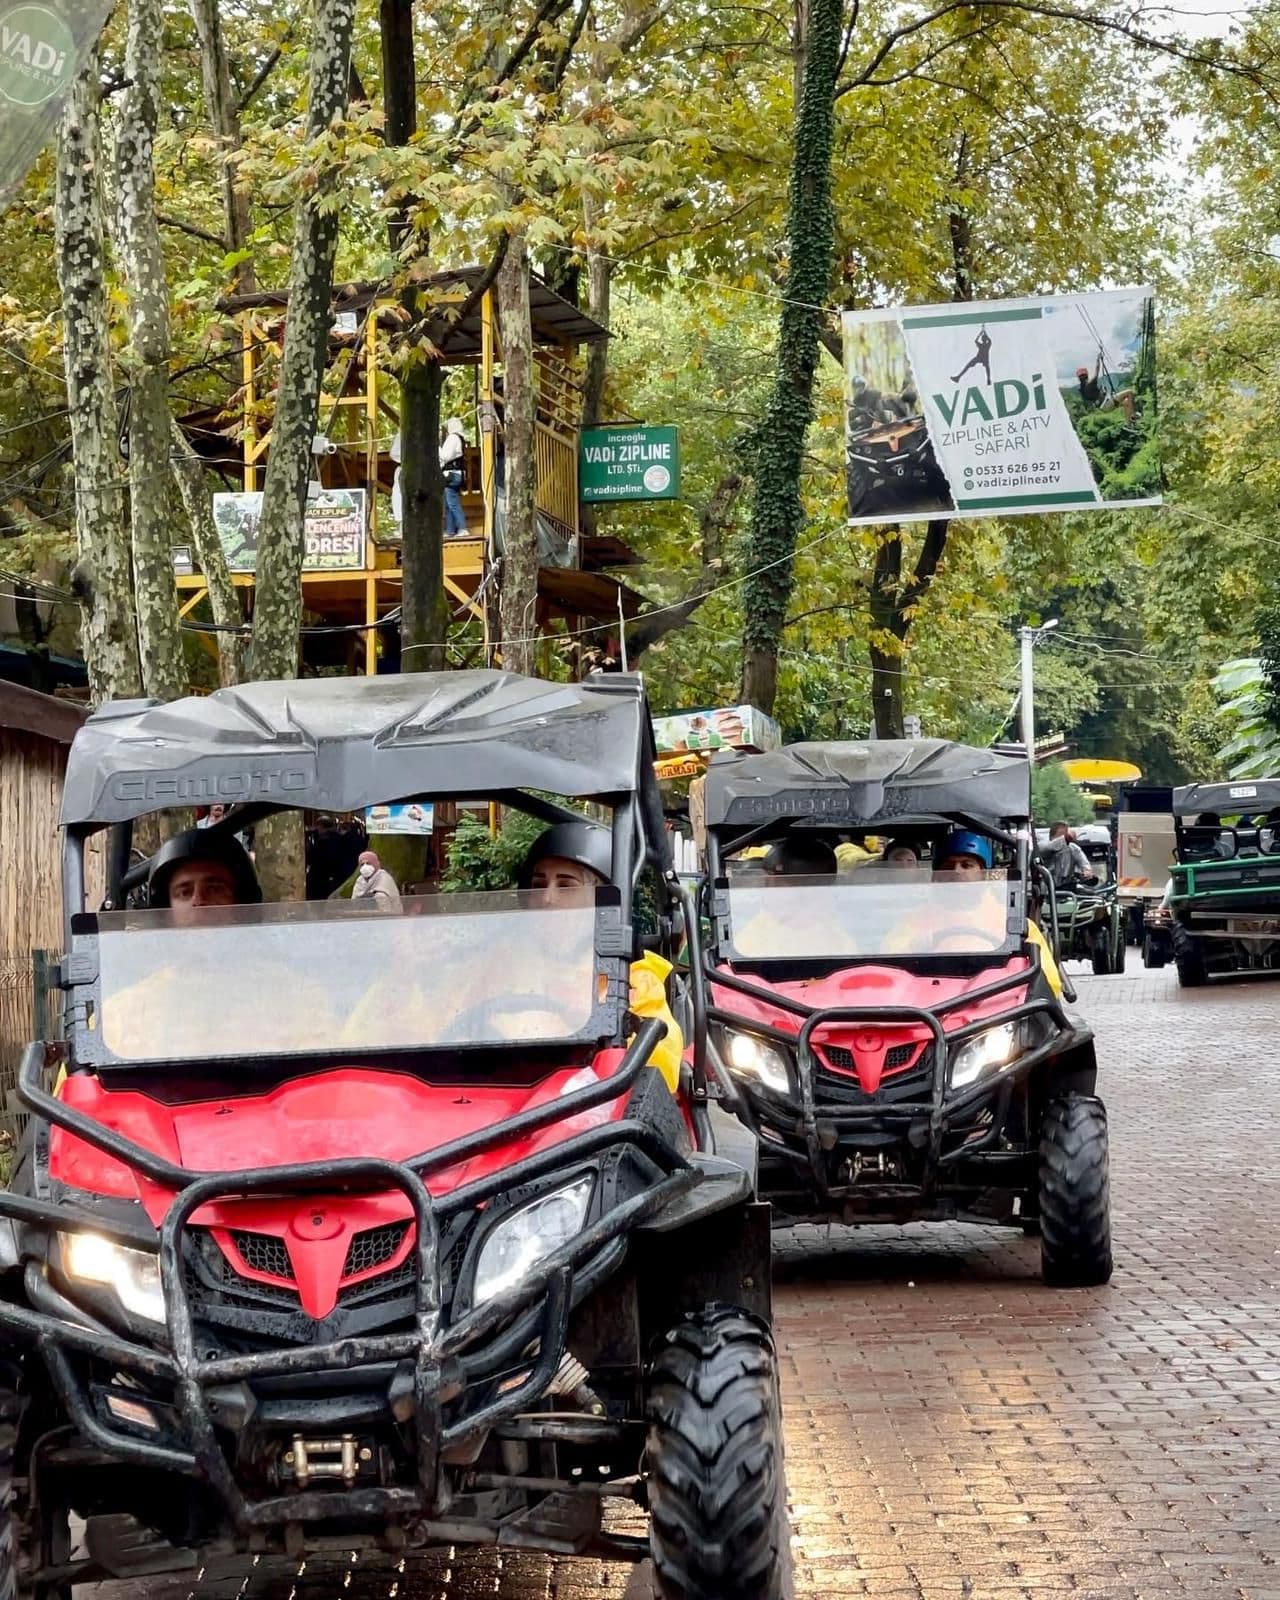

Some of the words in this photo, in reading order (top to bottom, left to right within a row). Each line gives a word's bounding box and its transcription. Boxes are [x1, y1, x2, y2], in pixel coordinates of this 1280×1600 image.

[942, 423, 1003, 447] ZIPLINE
[1007, 421, 1018, 434] &
[1021, 415, 1051, 432] ATV
[619, 443, 671, 462] ZIPLINE
[607, 464, 625, 475] LTD.
[975, 465, 1004, 476] 0533
[1007, 463, 1028, 474] 626
[1031, 462, 1046, 472] 95
[1049, 461, 1061, 471] 21
[976, 475, 1061, 488] vadiziplineatv
[593, 484, 643, 495] vadizipline
[111, 769, 311, 801] CFMOTO
